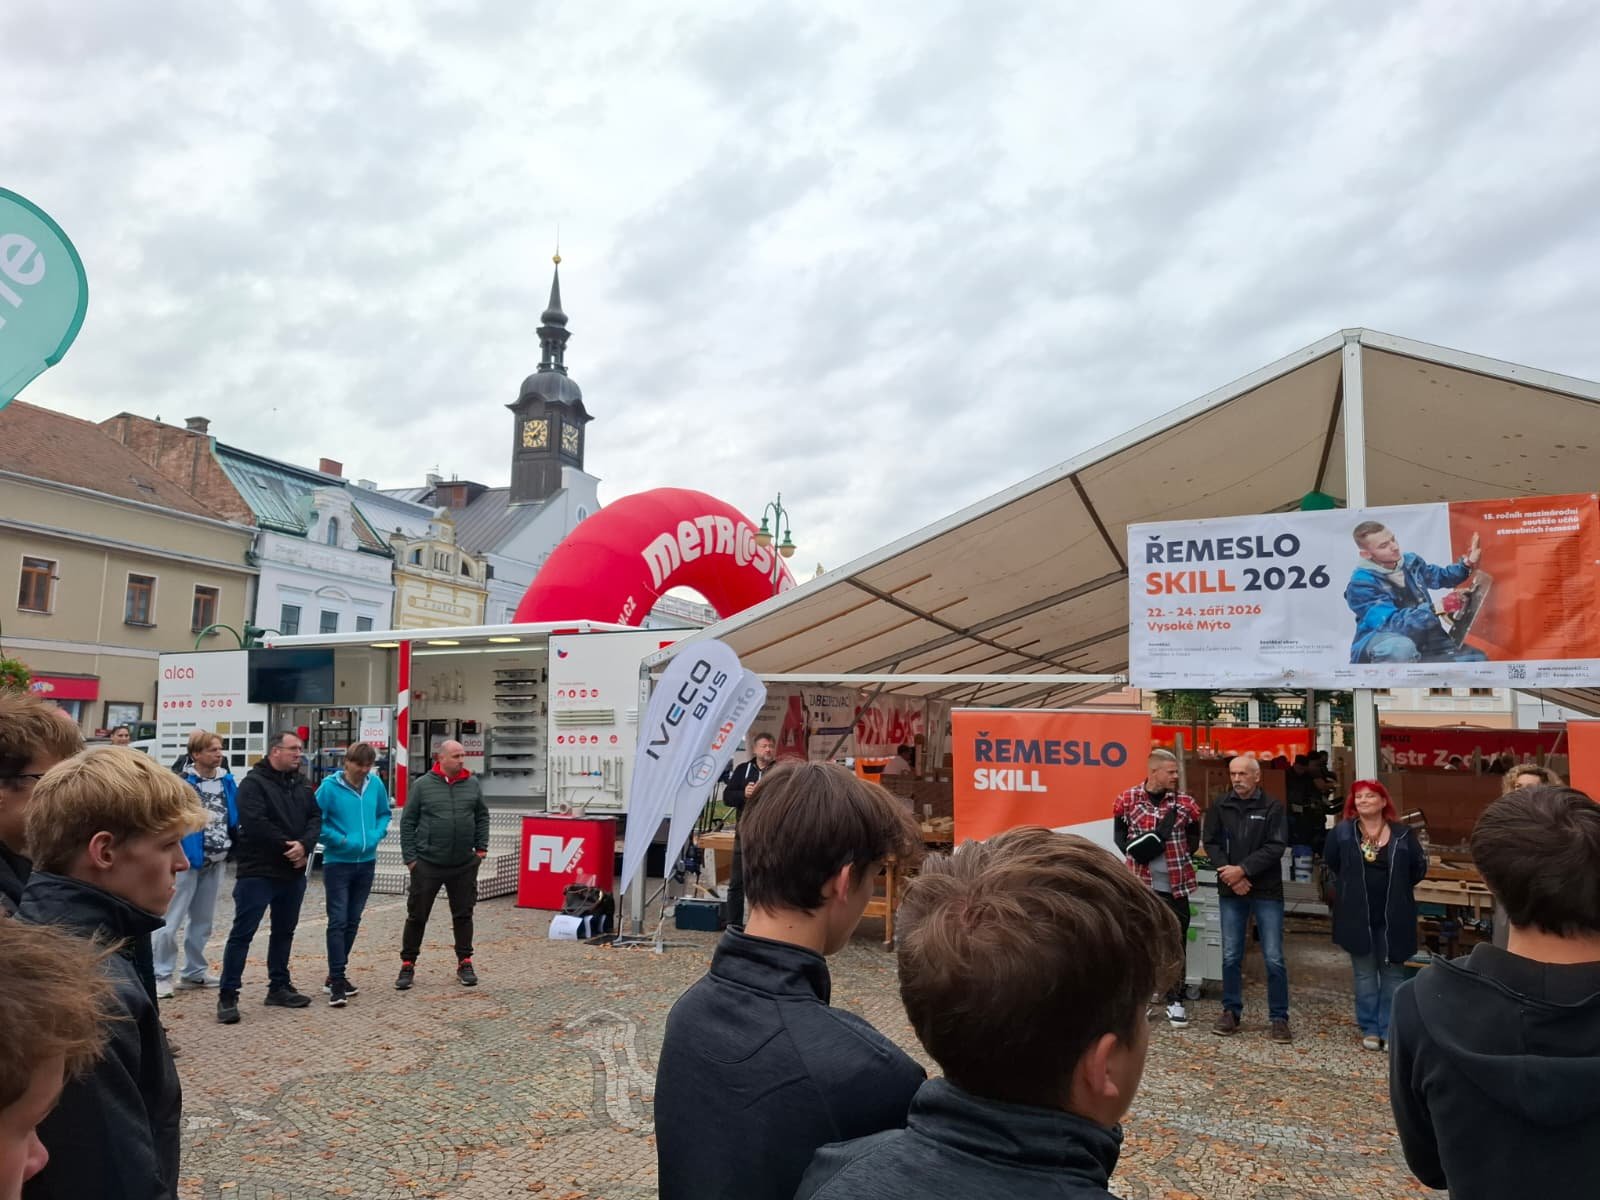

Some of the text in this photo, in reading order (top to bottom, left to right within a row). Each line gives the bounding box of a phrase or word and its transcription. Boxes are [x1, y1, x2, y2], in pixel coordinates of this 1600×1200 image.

[1146, 534, 1300, 564] ŘEMESLO
[1146, 565, 1330, 595] SKILL 2026
[1147, 608, 1166, 617] 22.
[1176, 607, 1196, 616] 24.
[1200, 605, 1224, 616] září
[1228, 604, 1262, 615] 2026
[1147, 618, 1231, 632] Vysoké Mýto
[164, 665, 194, 680] alca
[693, 670, 728, 720] BUS
[646, 659, 711, 760] IVECO
[364, 728, 384, 736] alca
[974, 731, 1127, 767] ŘEMESLO
[973, 768, 1048, 793] SKILL
[528, 834, 585, 874] FV
[566, 847, 585, 874] PLAST
